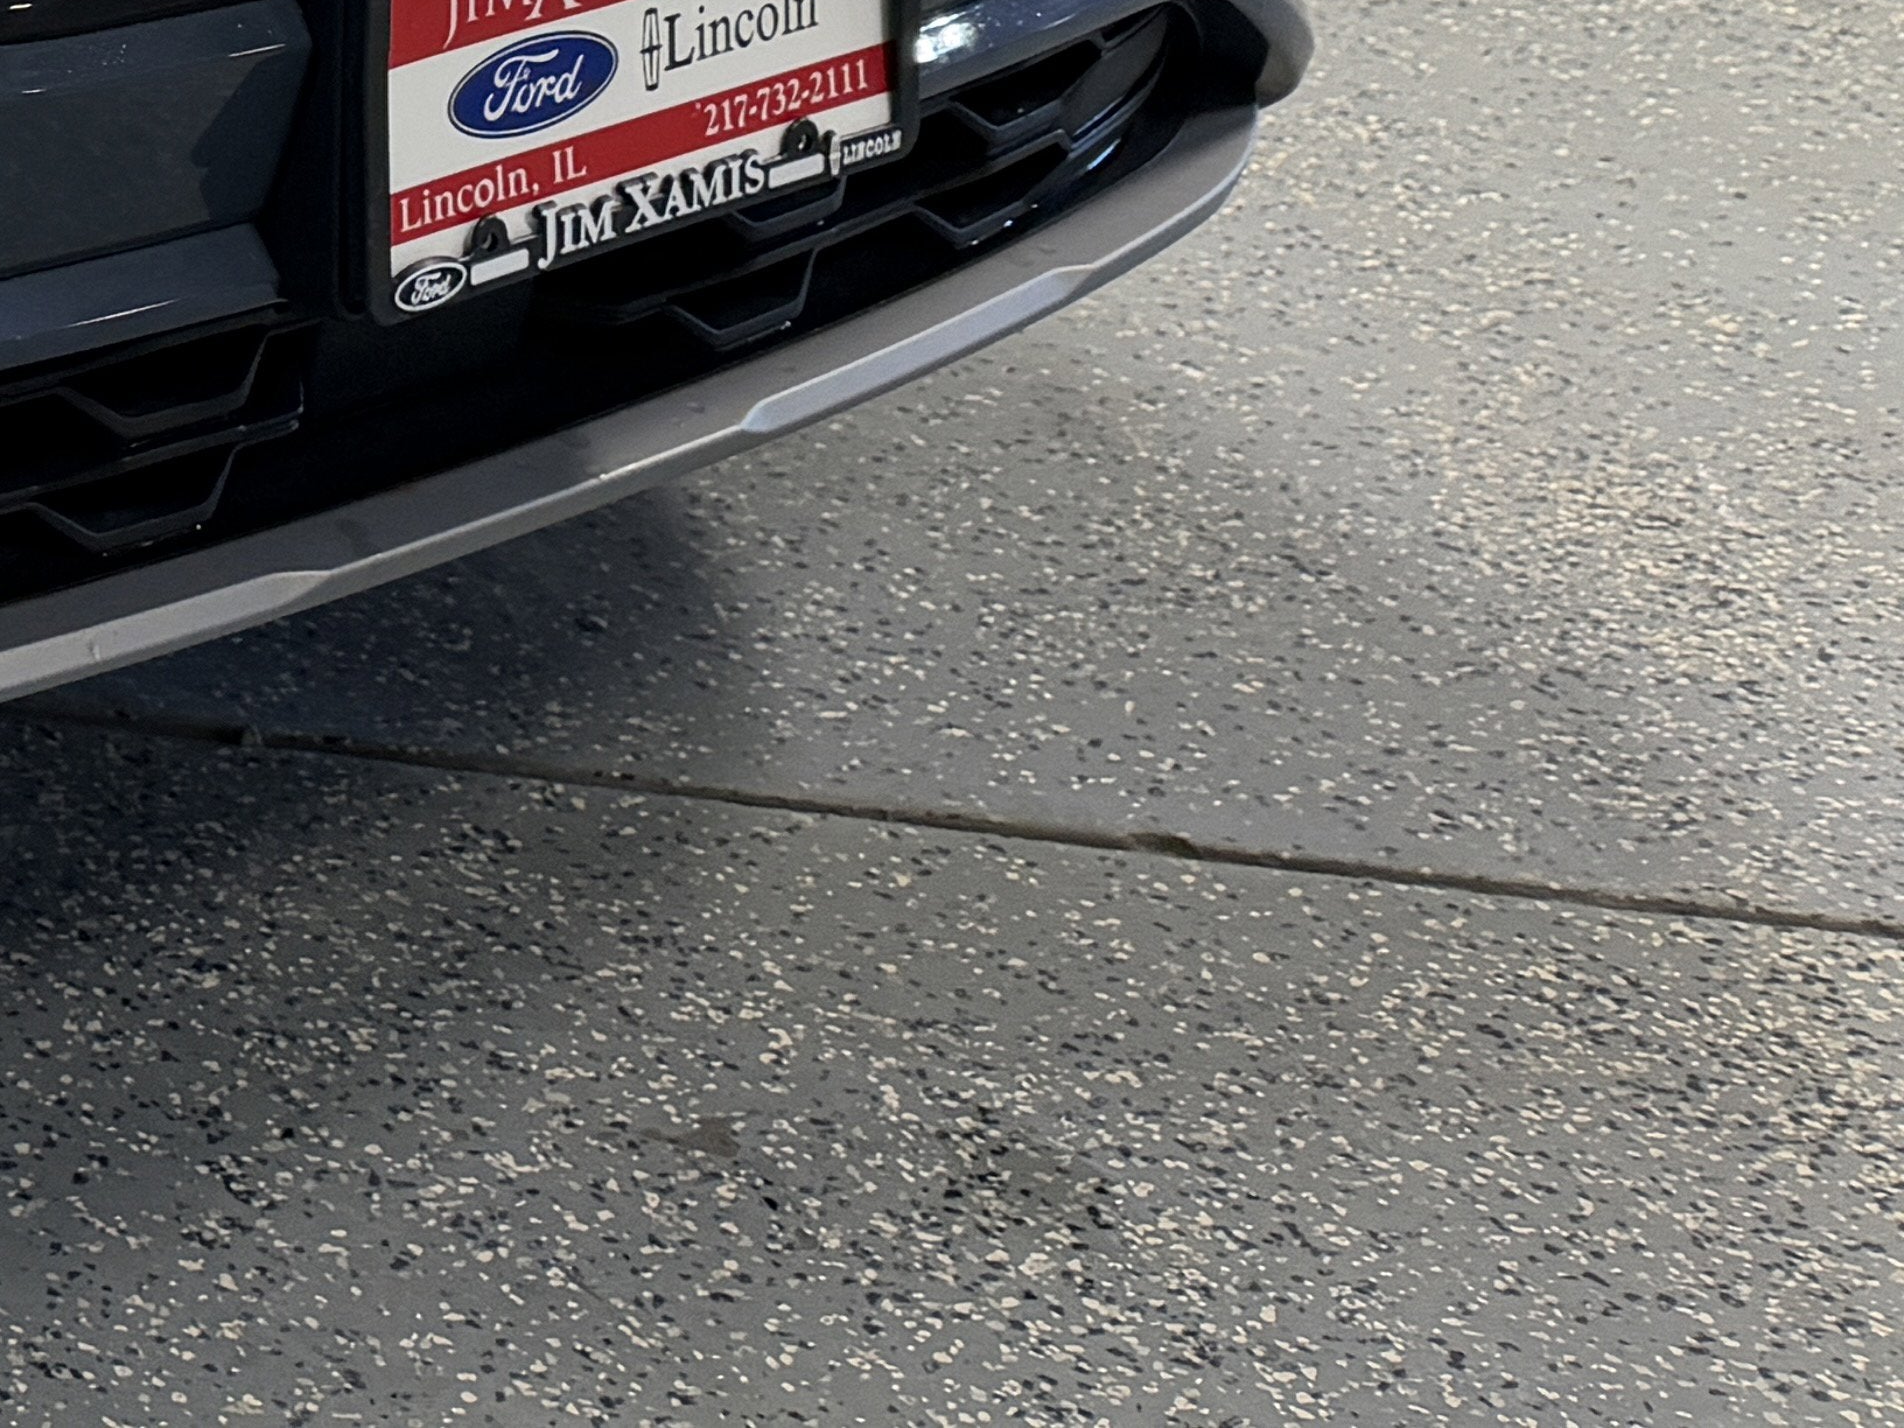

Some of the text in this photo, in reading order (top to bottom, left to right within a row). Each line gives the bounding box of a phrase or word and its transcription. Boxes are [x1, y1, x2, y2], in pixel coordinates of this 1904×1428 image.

[483, 48, 585, 122] Ford
[703, 59, 868, 137] 217-732-2111
[400, 145, 587, 233] Lincoln, IL
[537, 154, 766, 270] JIM XAMIS
[411, 271, 452, 305] Ford
